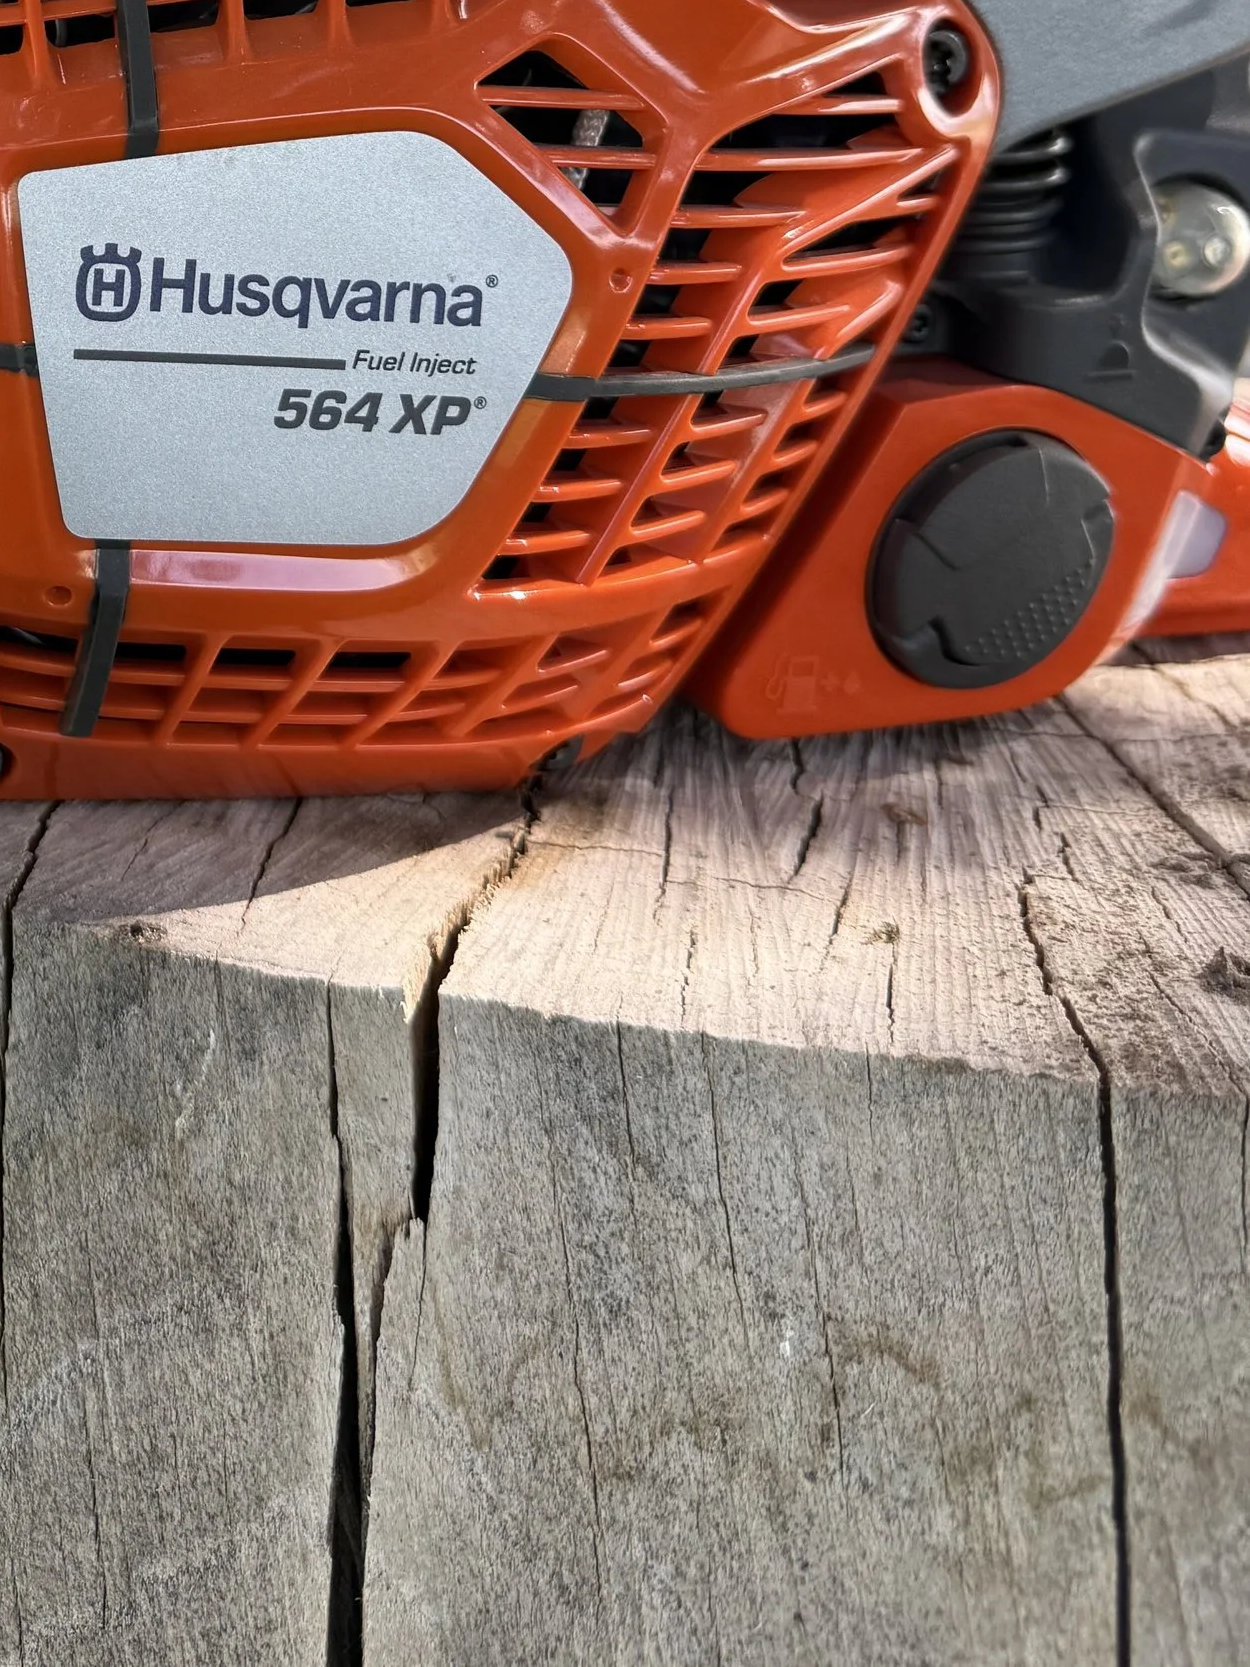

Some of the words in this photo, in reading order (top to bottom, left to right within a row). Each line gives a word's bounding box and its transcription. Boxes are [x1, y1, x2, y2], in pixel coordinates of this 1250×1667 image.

[352, 349, 405, 372] Fuel
[409, 352, 477, 377] Inject
[273, 388, 383, 433] 564
